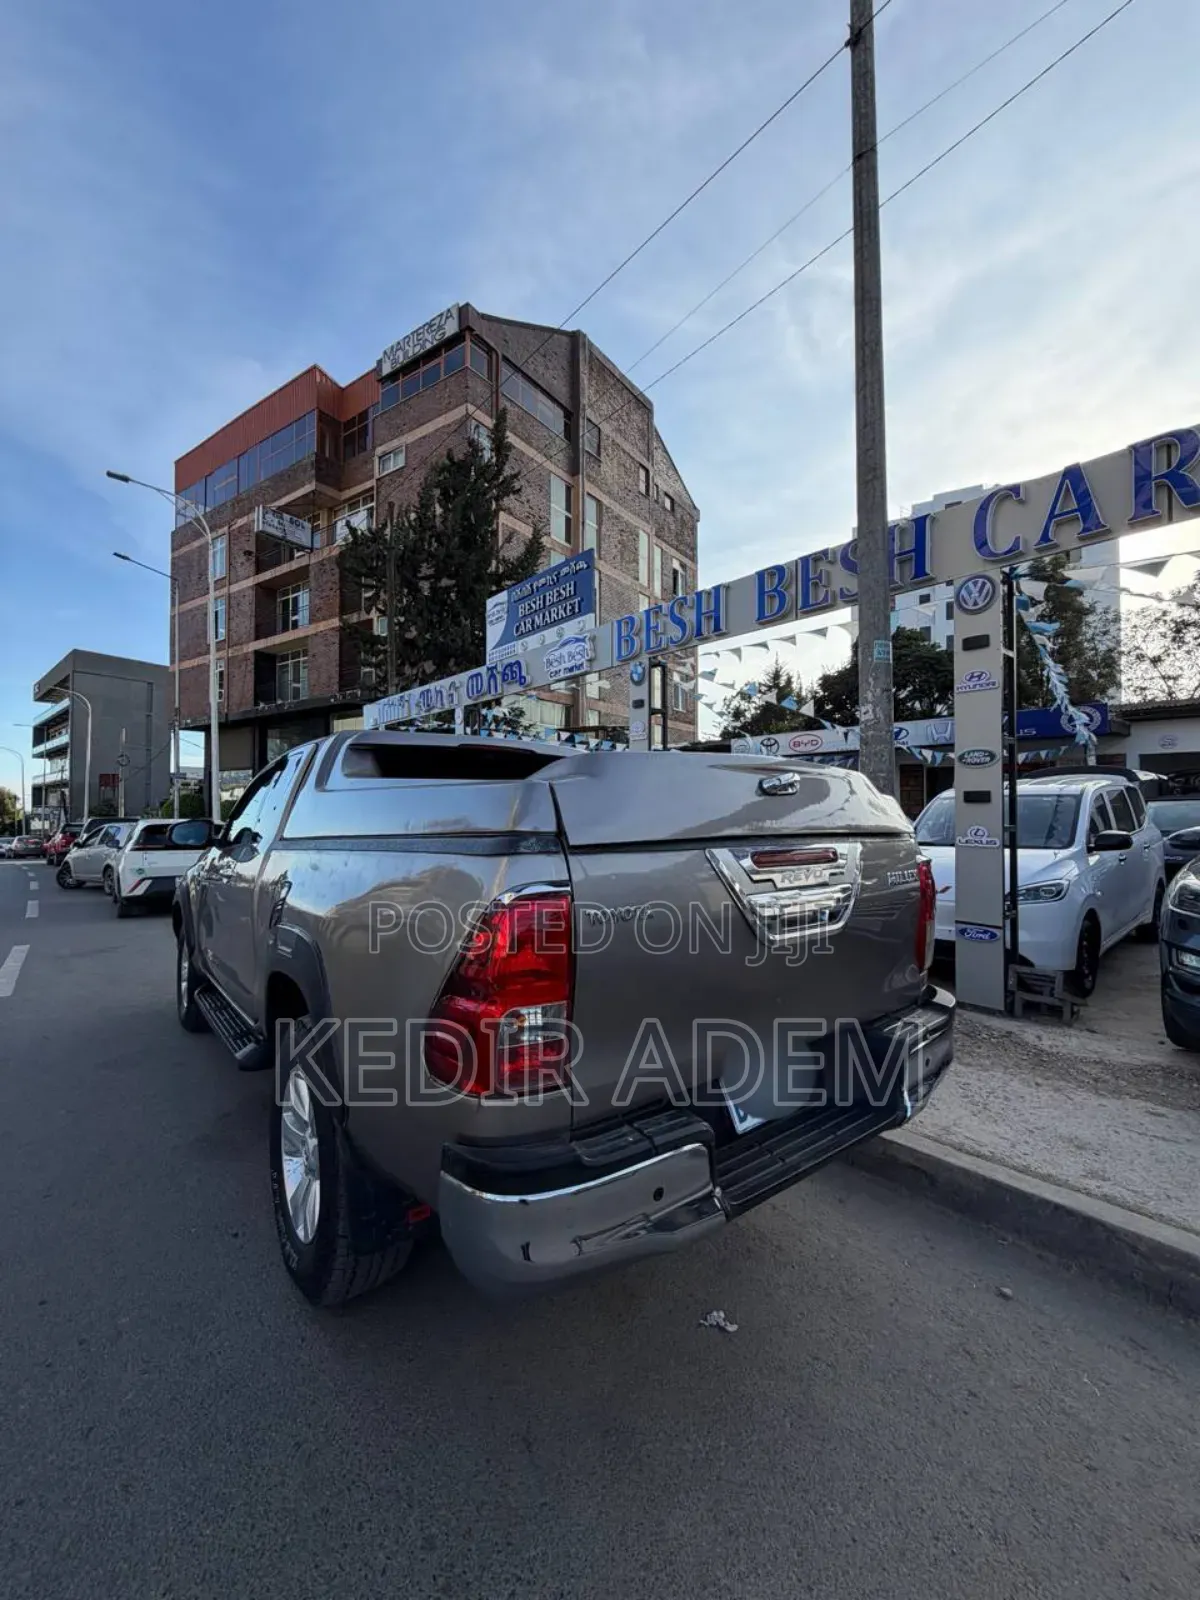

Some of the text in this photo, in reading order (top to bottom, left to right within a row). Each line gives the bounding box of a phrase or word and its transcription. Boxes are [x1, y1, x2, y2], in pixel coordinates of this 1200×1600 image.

[615, 583, 728, 662] BESH
[973, 427, 1200, 561] CAR
[518, 581, 575, 617] BESH BESH
[514, 618, 533, 636] CAR
[533, 597, 581, 629] MARKET
[793, 740, 819, 748] BYD
[958, 838, 997, 847] LEXUS
[780, 868, 823, 884] REVO
[585, 905, 653, 925] TOYOTA
[964, 929, 991, 940] Ford
